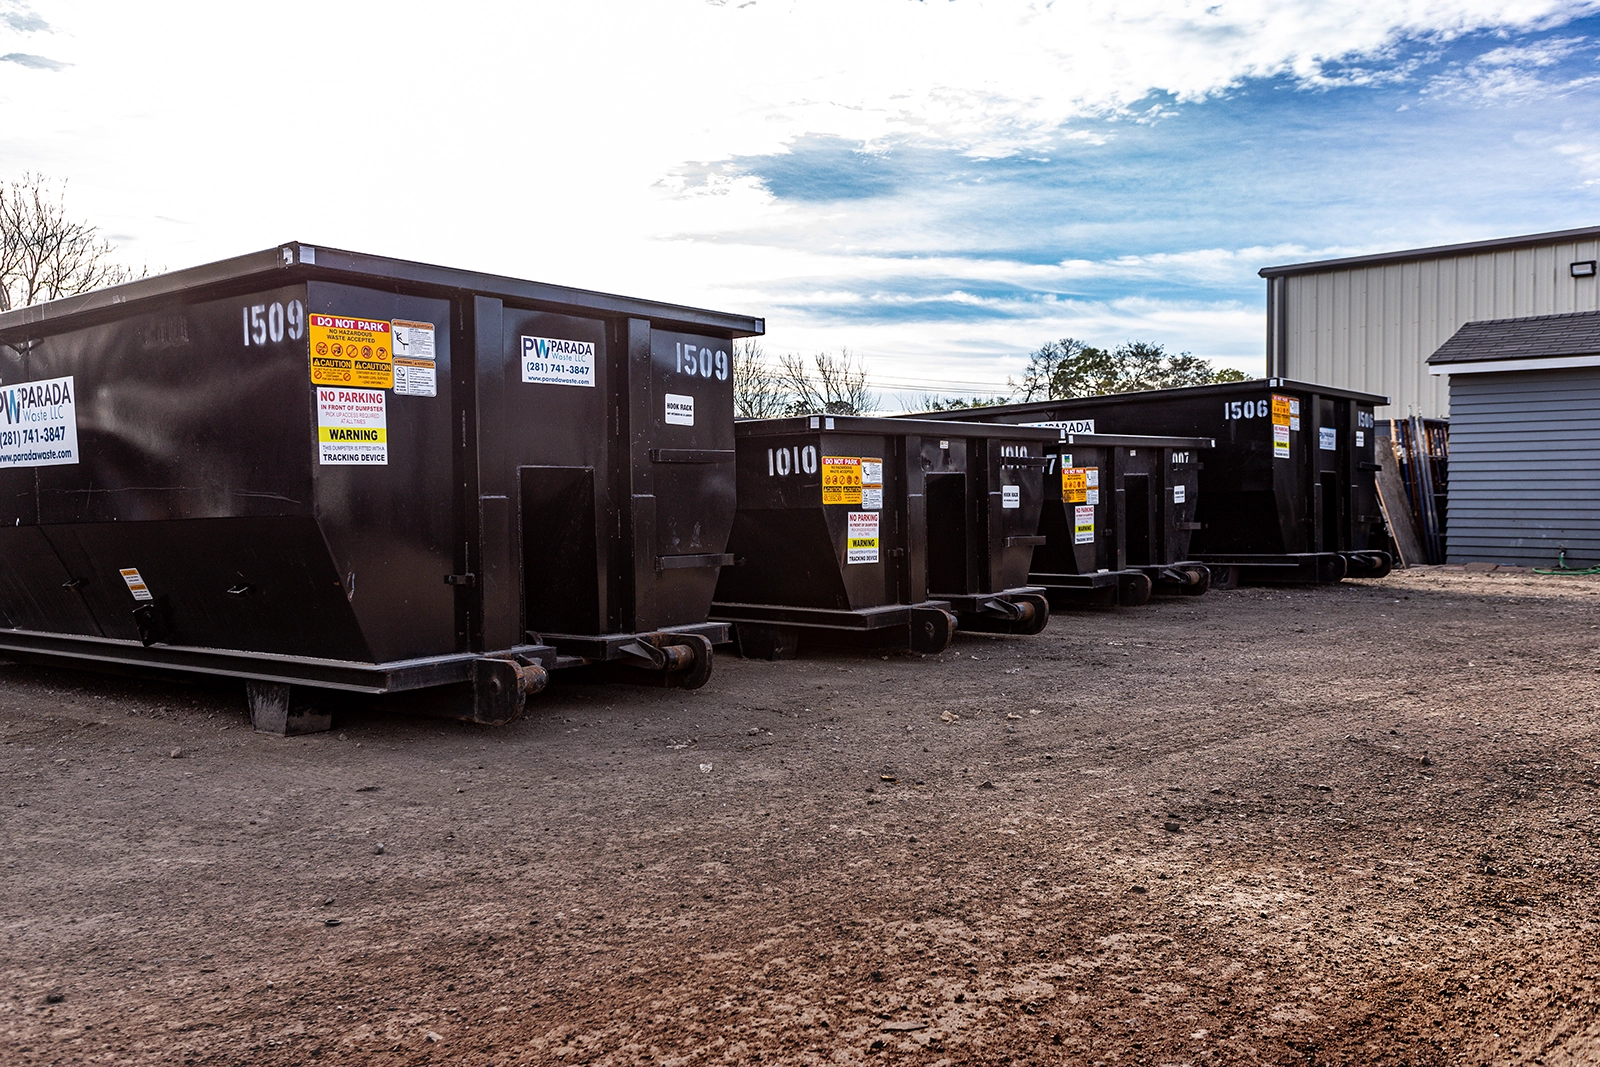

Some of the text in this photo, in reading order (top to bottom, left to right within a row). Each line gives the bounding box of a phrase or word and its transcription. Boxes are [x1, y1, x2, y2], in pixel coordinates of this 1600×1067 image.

[243, 299, 304, 346] 1509
[318, 317, 332, 326] DO
[336, 318, 355, 328] NOT
[358, 321, 384, 332] PARK
[339, 329, 372, 337] HAZARDOUS
[552, 340, 592, 355] PARADA
[552, 352, 586, 362] Waste LLC
[676, 342, 728, 381] 1509
[320, 360, 351, 368] CAUTION
[361, 362, 391, 371] CAUTION
[527, 362, 589, 375] (281) 741-3847
[528, 376, 590, 384] www.paradawaste.com
[21, 381, 71, 409] PARADA
[320, 390, 383, 404] NO PARKING
[667, 402, 679, 410] HOOK
[1225, 399, 1268, 420] 1506
[22, 405, 64, 422] Waste LLC
[0, 426, 65, 449] (281) 741-3847
[329, 429, 378, 441] WARNING
[768, 445, 817, 476] 1010
[850, 514, 878, 522] NO PARKING
[852, 539, 875, 547] WARNING
